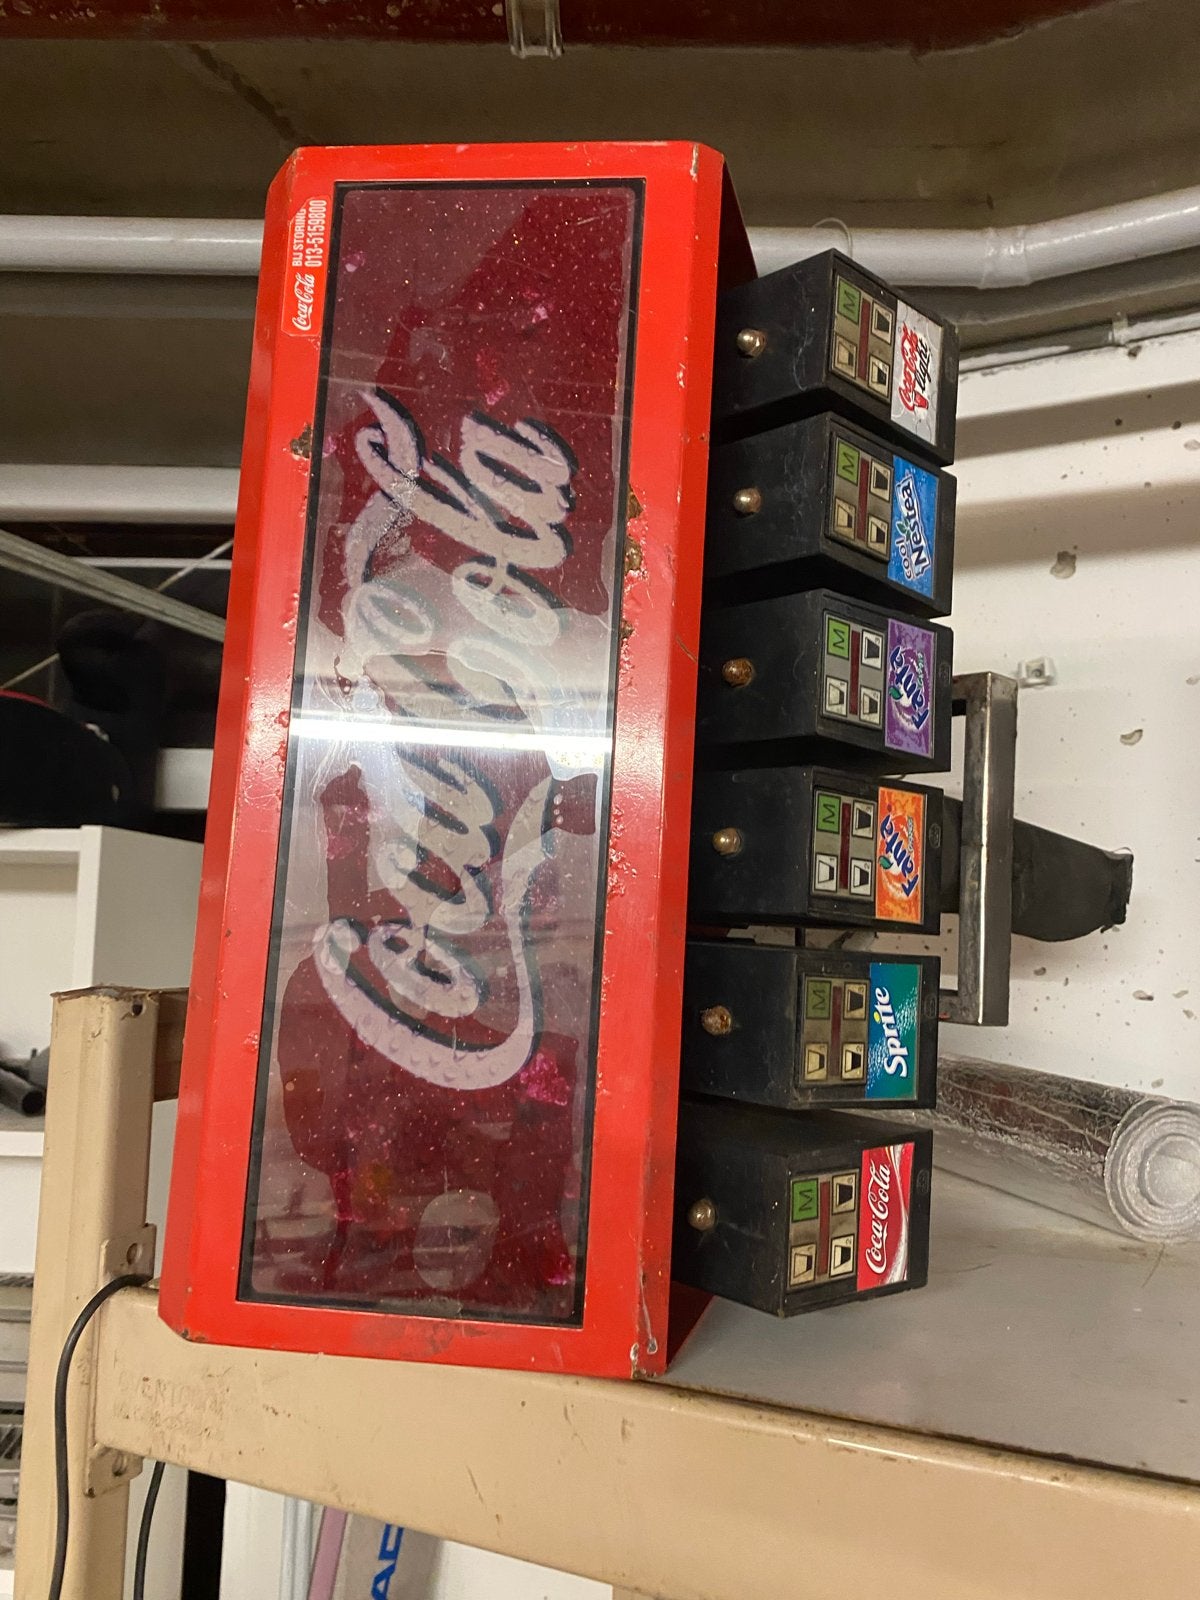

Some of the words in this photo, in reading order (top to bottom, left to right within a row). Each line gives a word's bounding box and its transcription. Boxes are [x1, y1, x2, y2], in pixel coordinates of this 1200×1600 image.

[292, 252, 303, 267] BIJ
[305, 200, 327, 267] 013-5159800
[292, 271, 315, 331] Coca-Cola
[843, 290, 856, 314] M
[915, 338, 931, 392] light
[842, 452, 856, 476] M
[901, 481, 927, 568] Nestea
[895, 539, 912, 579] cool
[832, 628, 846, 650] M
[890, 646, 929, 730] Fanta
[313, 388, 578, 1091] CocaCola
[822, 803, 836, 824] M
[880, 814, 919, 897] Fanta
[812, 989, 826, 1010] M
[873, 986, 909, 1078] Sprite
[798, 1189, 813, 1212] M
[865, 1160, 891, 1274] Coca-Cola
